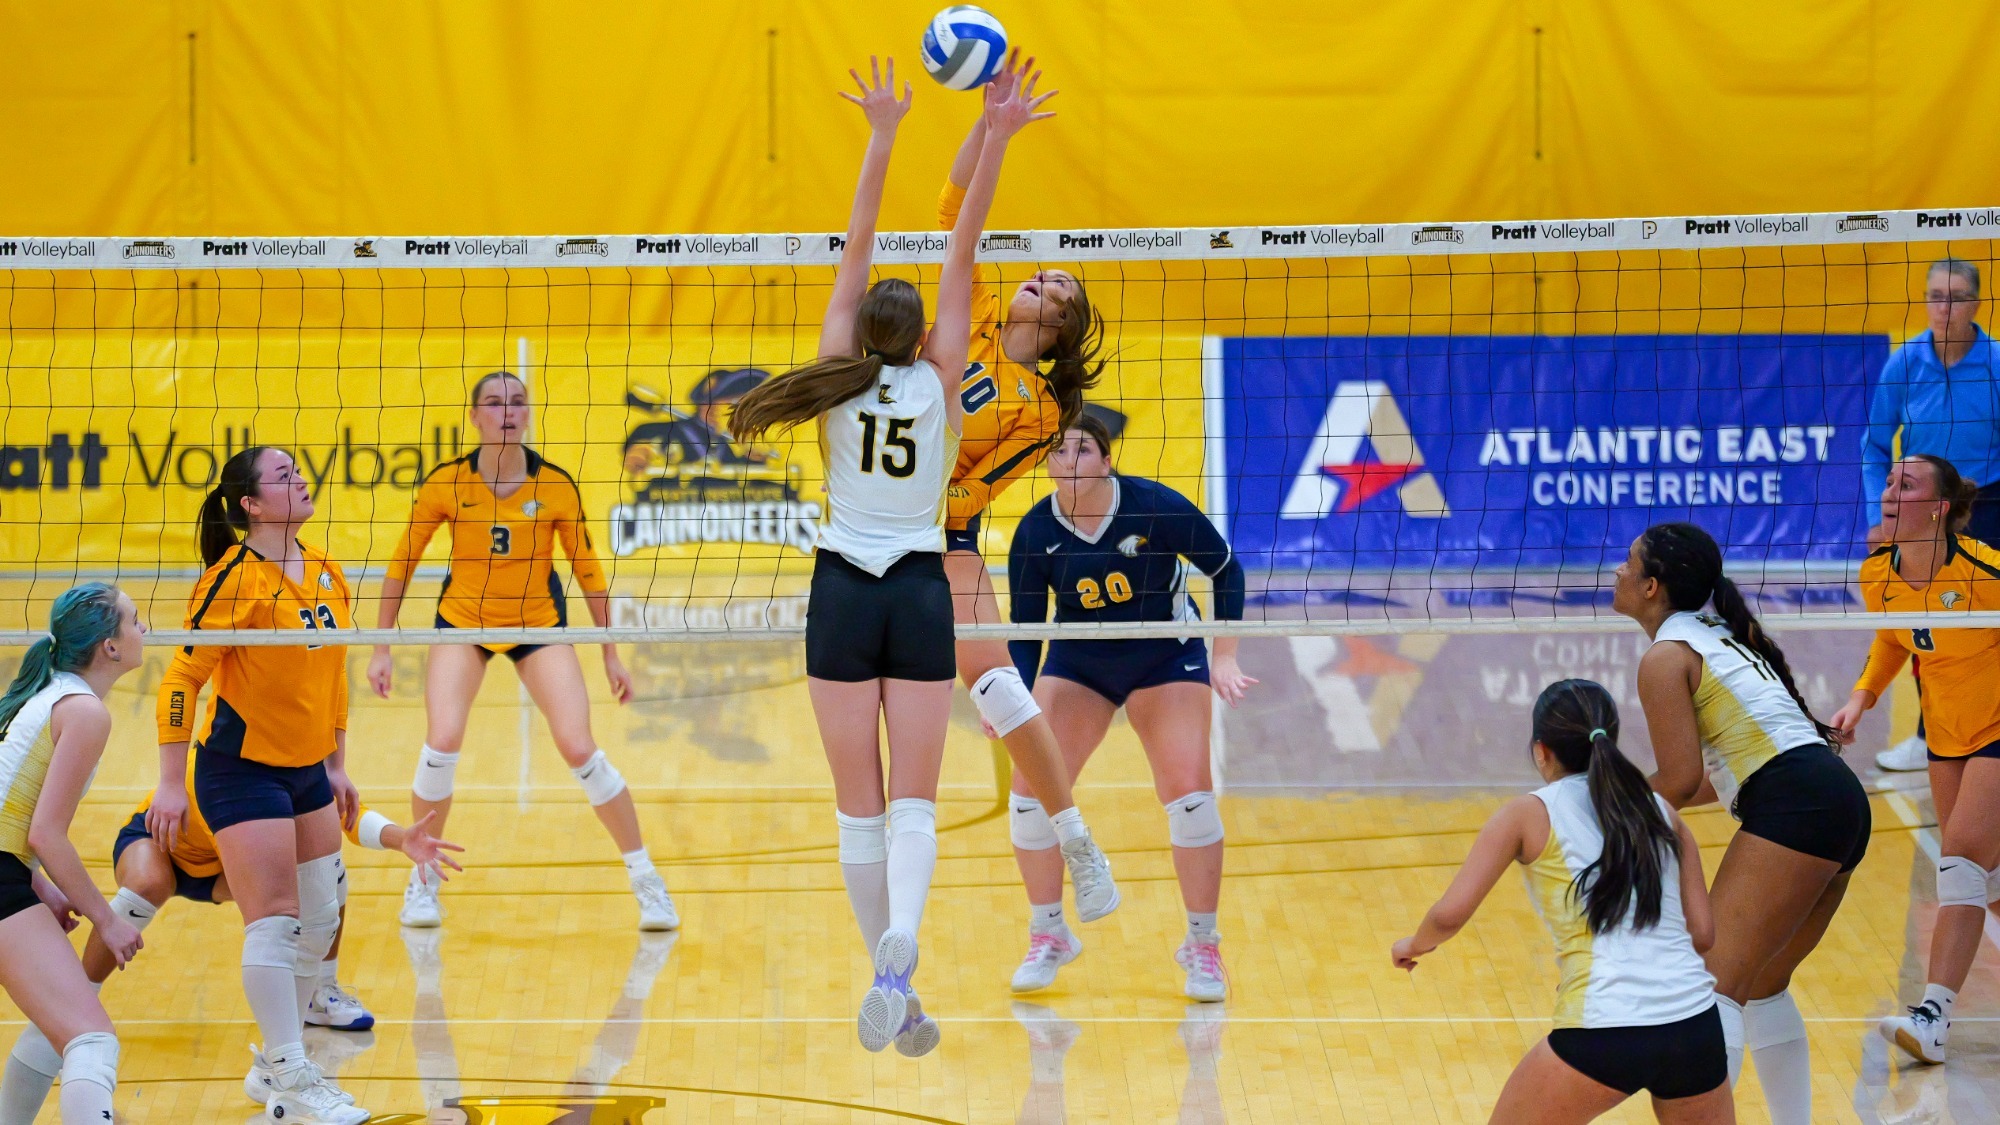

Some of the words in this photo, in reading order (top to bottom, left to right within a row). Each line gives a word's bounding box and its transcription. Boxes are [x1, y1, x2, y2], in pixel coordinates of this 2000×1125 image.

[1685, 220, 1730, 234] Pratt
[1735, 217, 1808, 236] Volleyball
[1836, 218, 1889, 233] CANNONEERS
[1917, 213, 1962, 228] Pratt
[1060, 234, 1104, 248] Pratt
[1108, 231, 1182, 250] Volleyball
[1261, 231, 1306, 245] Pratt
[1310, 228, 1384, 247] Volleyball
[1412, 230, 1464, 245] CANNONEERS
[1492, 225, 1537, 239] Pratt
[1541, 222, 1615, 241] Volleyball
[22, 242, 95, 260] Volleyball
[123, 245, 175, 259] CANNONEERS
[203, 241, 247, 256] Pratt
[252, 241, 326, 258] Volleyball
[406, 240, 450, 255] Pratt
[455, 239, 528, 257] Volleyball
[556, 243, 608, 257] CANNONEERS
[637, 239, 681, 254] Pratt
[685, 237, 758, 256] Volleyball
[878, 235, 947, 254] Volleybal
[980, 238, 1031, 252] CANNONEERS
[858, 411, 916, 479] 15
[1479, 426, 1701, 466] ATLANTIC
[1717, 426, 1835, 463] EAST
[1533, 471, 1783, 506] CONFERENCE
[610, 502, 821, 557] CANNONEERS
[490, 525, 510, 556] 3
[1076, 572, 1133, 609] 20
[1719, 637, 1777, 681] 11
[170, 691, 185, 727] GOLDEN
